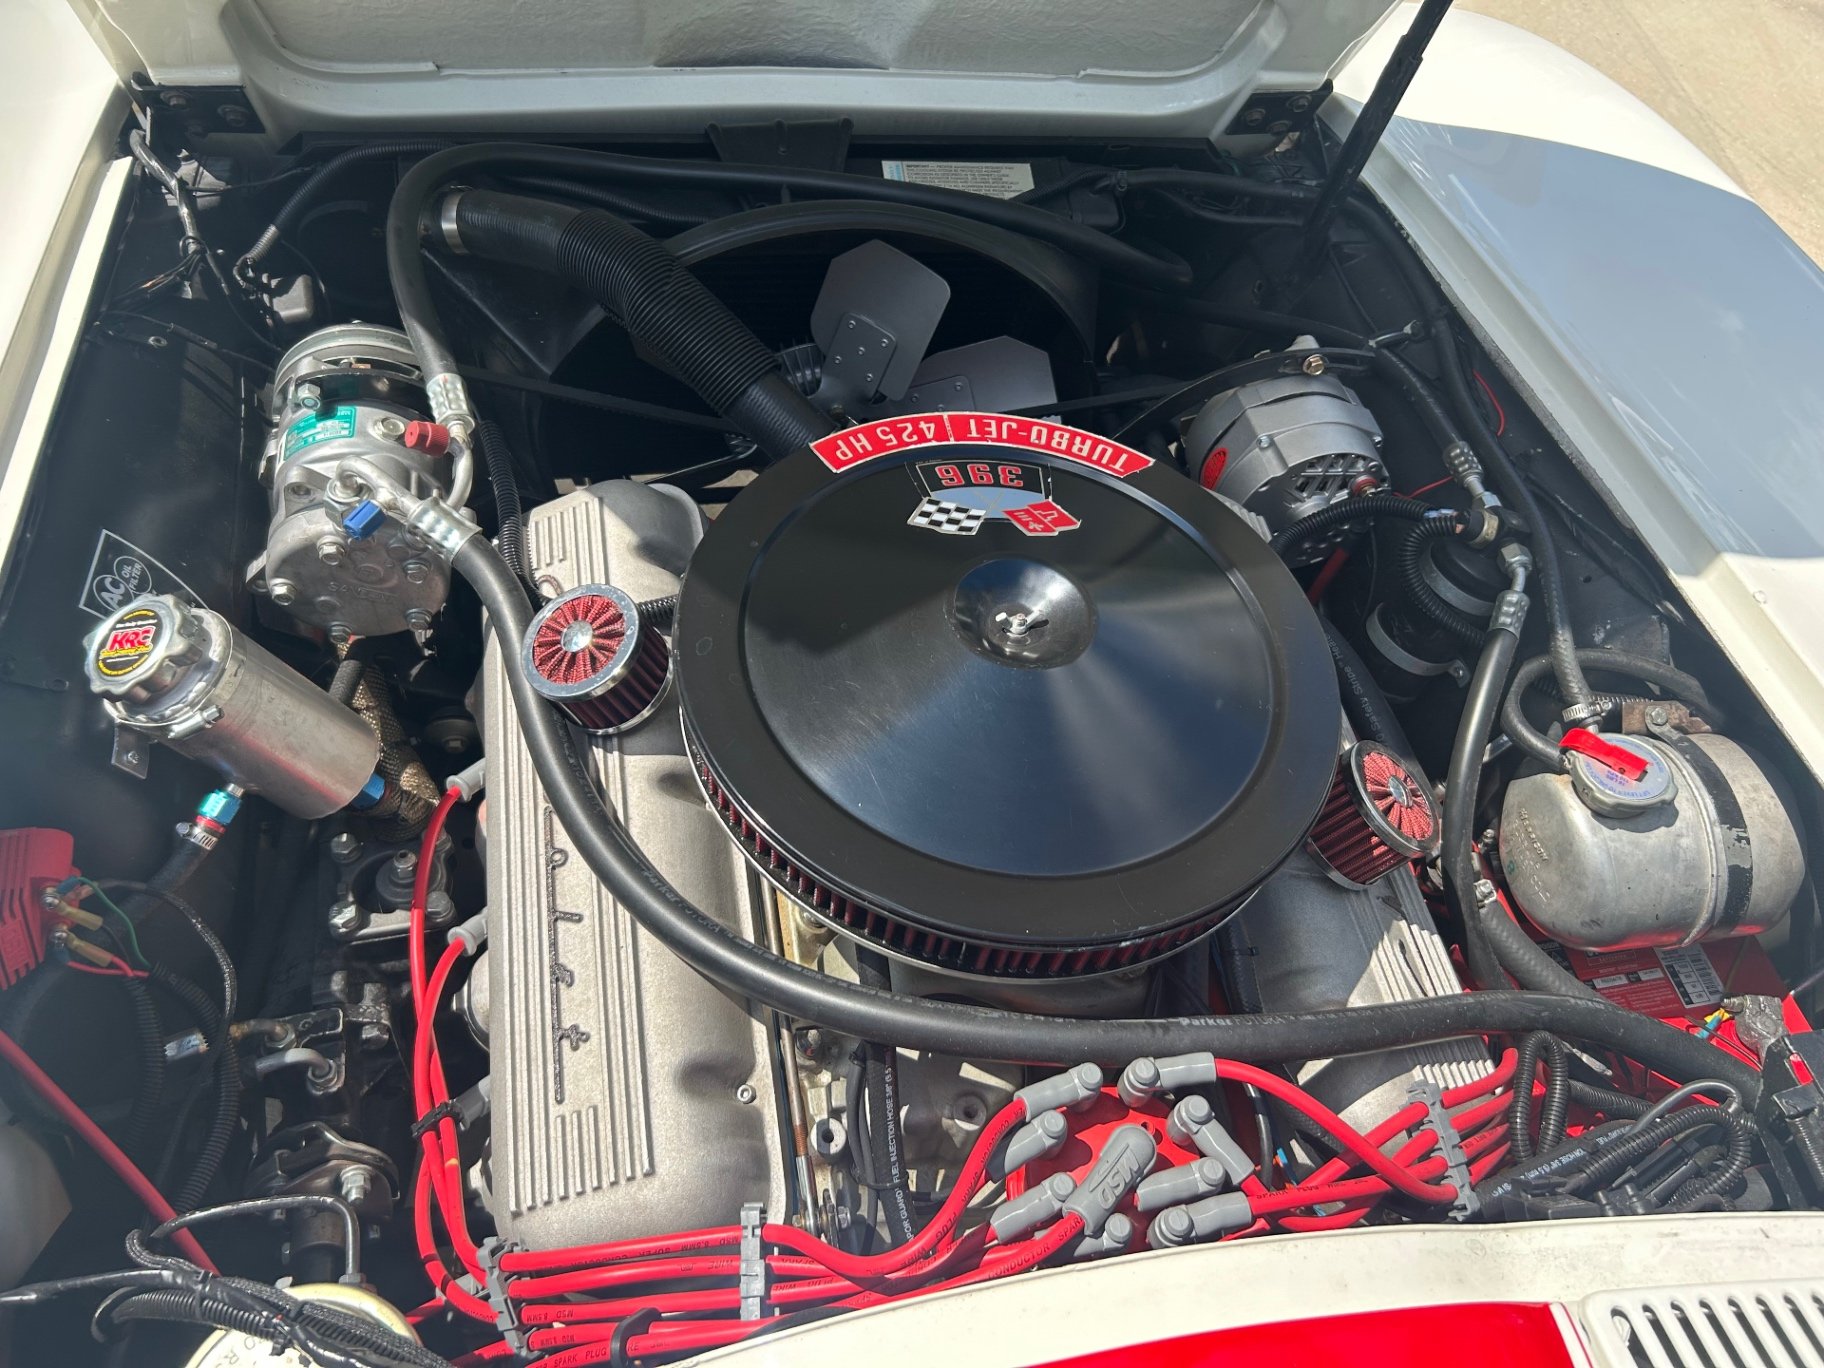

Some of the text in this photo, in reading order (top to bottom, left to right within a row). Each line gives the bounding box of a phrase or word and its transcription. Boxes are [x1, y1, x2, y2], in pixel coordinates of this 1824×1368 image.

[834, 418, 1129, 472] TURBO-JET 425 HP
[936, 463, 1024, 488] 396
[121, 564, 133, 578] OIL
[128, 562, 143, 592] FILTER
[100, 576, 126, 609] AC
[107, 626, 156, 652] KRC
[885, 1097, 895, 1120] HOSE
[888, 1121, 898, 1163] INJECTION
[891, 1164, 901, 1184] FUEL
[1100, 1150, 1143, 1210] MSD
[935, 1212, 957, 1241] PLUG
[988, 1243, 1051, 1279] CONDUCTOR
[556, 1310, 574, 1319] MSD
[554, 1354, 578, 1368] SPARK
[585, 1347, 607, 1360] PLUG
